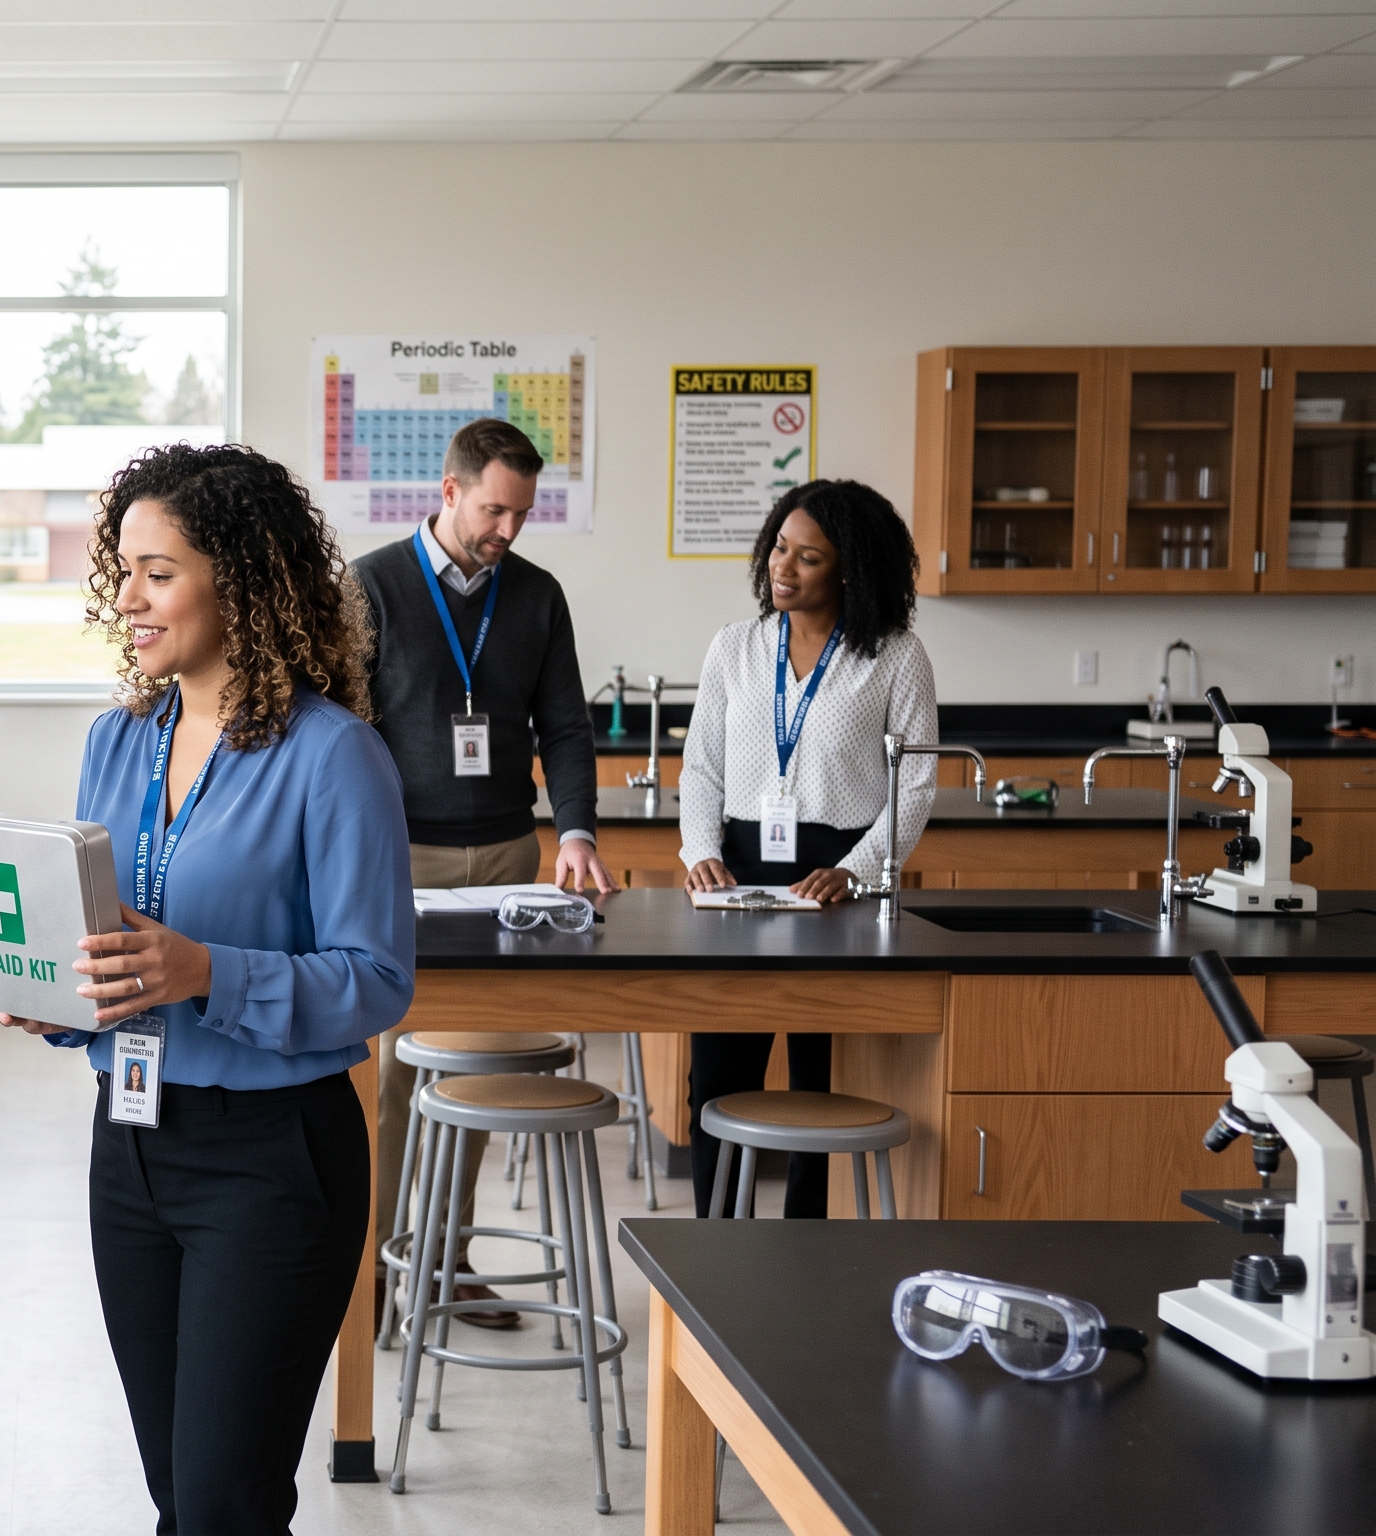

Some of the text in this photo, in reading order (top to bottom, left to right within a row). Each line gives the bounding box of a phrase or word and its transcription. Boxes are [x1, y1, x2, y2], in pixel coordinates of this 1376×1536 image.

[391, 340, 517, 358] Periodic Table
[678, 372, 808, 392] SAFETY RULES
[29, 958, 57, 983] KIT
